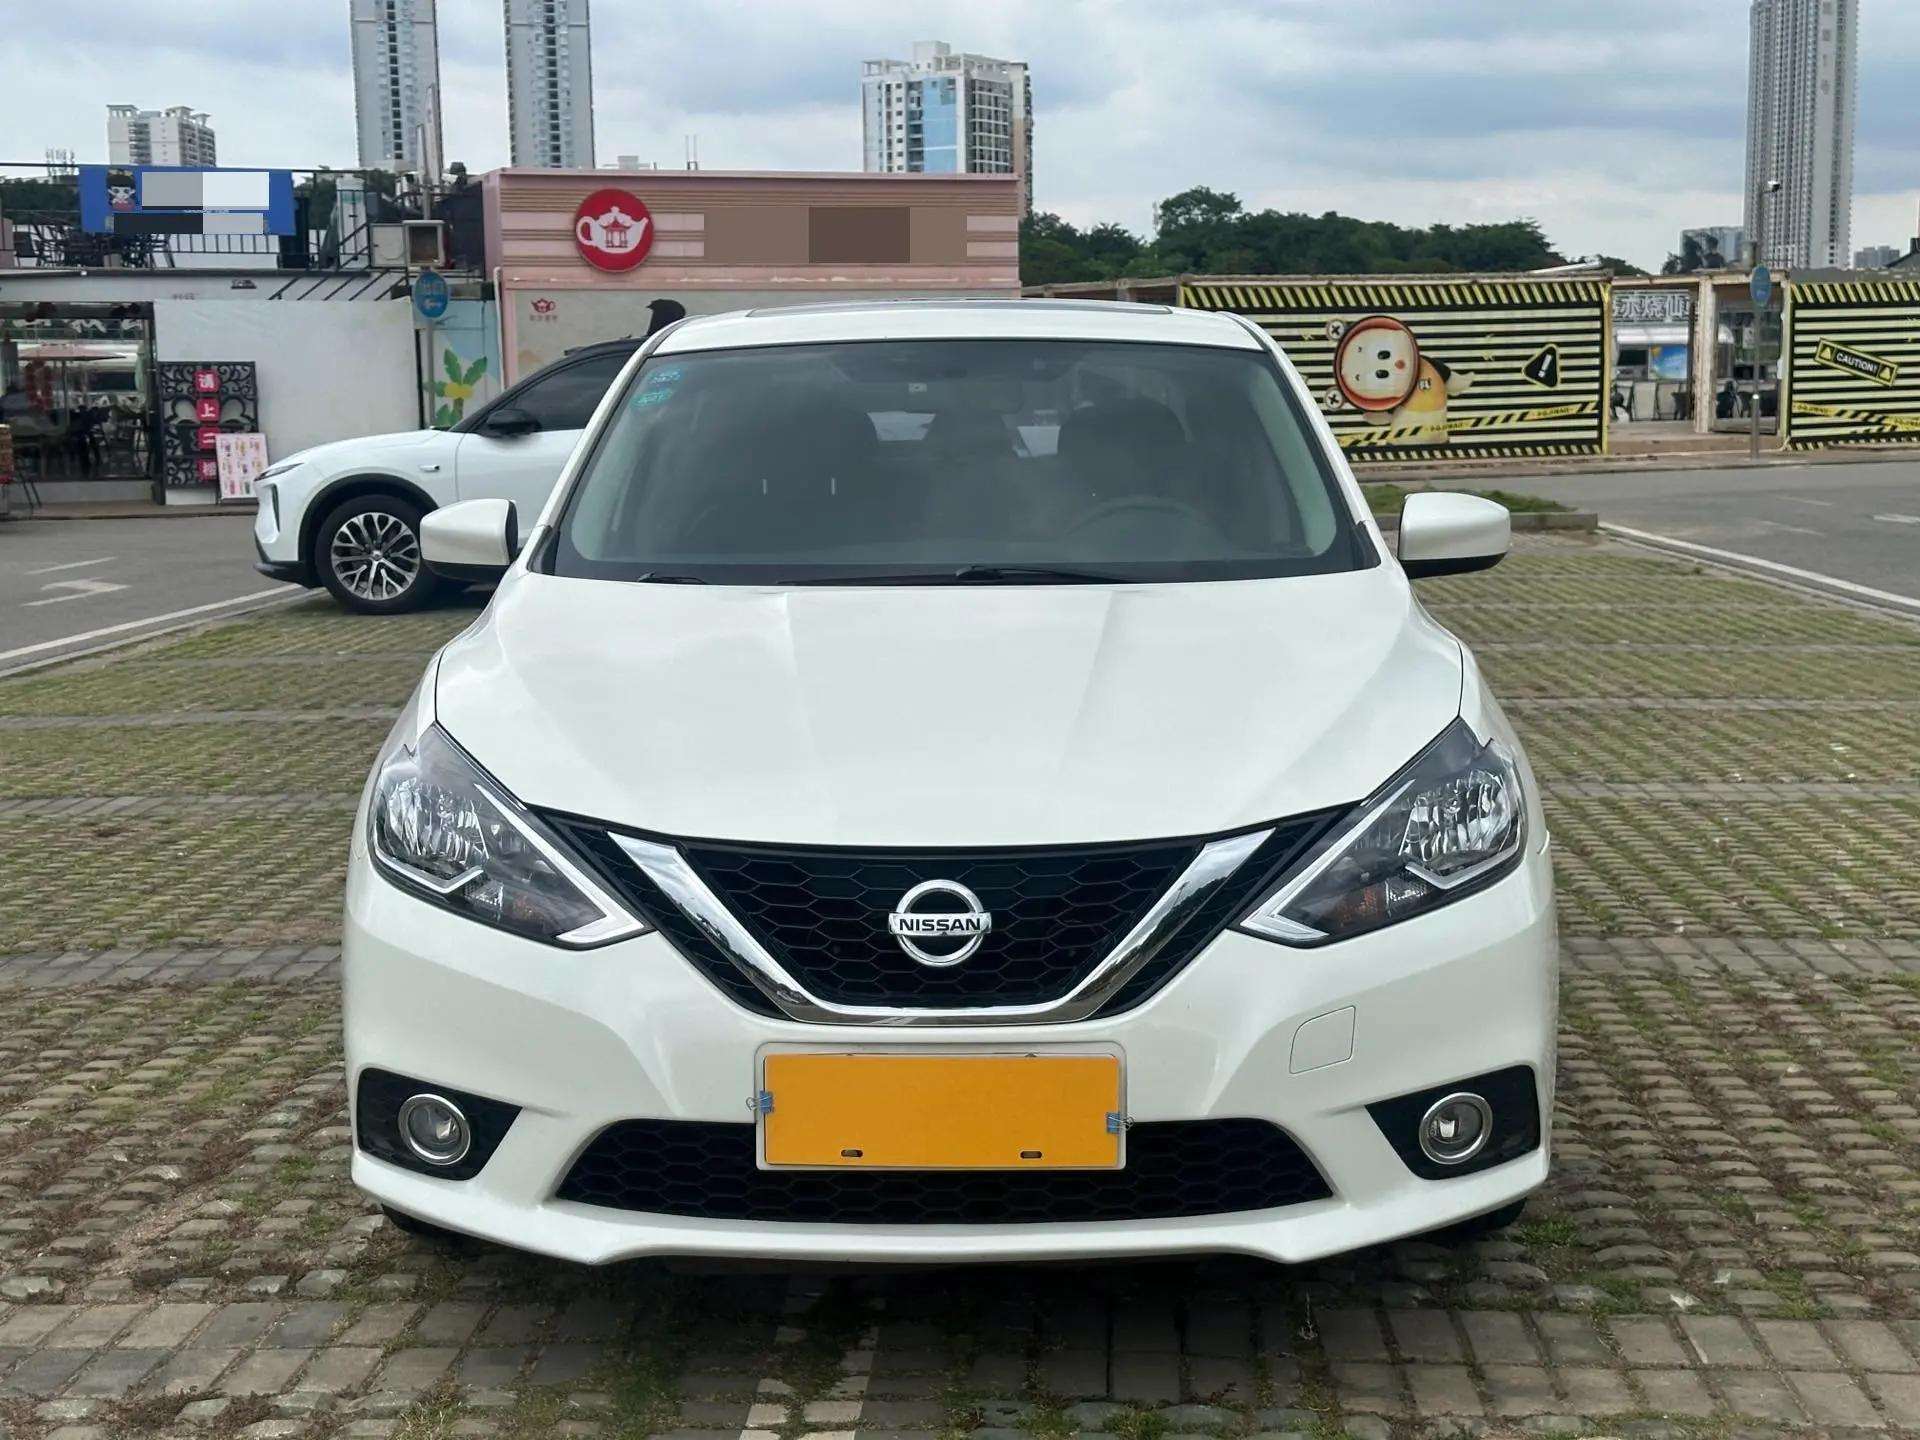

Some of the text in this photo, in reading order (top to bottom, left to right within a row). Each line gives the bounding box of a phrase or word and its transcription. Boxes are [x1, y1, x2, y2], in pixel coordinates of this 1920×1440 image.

[1613, 294, 1689, 318] 亦烧仙
[1836, 352, 1878, 373] CAUTION!
[899, 918, 981, 931] NISSAN
